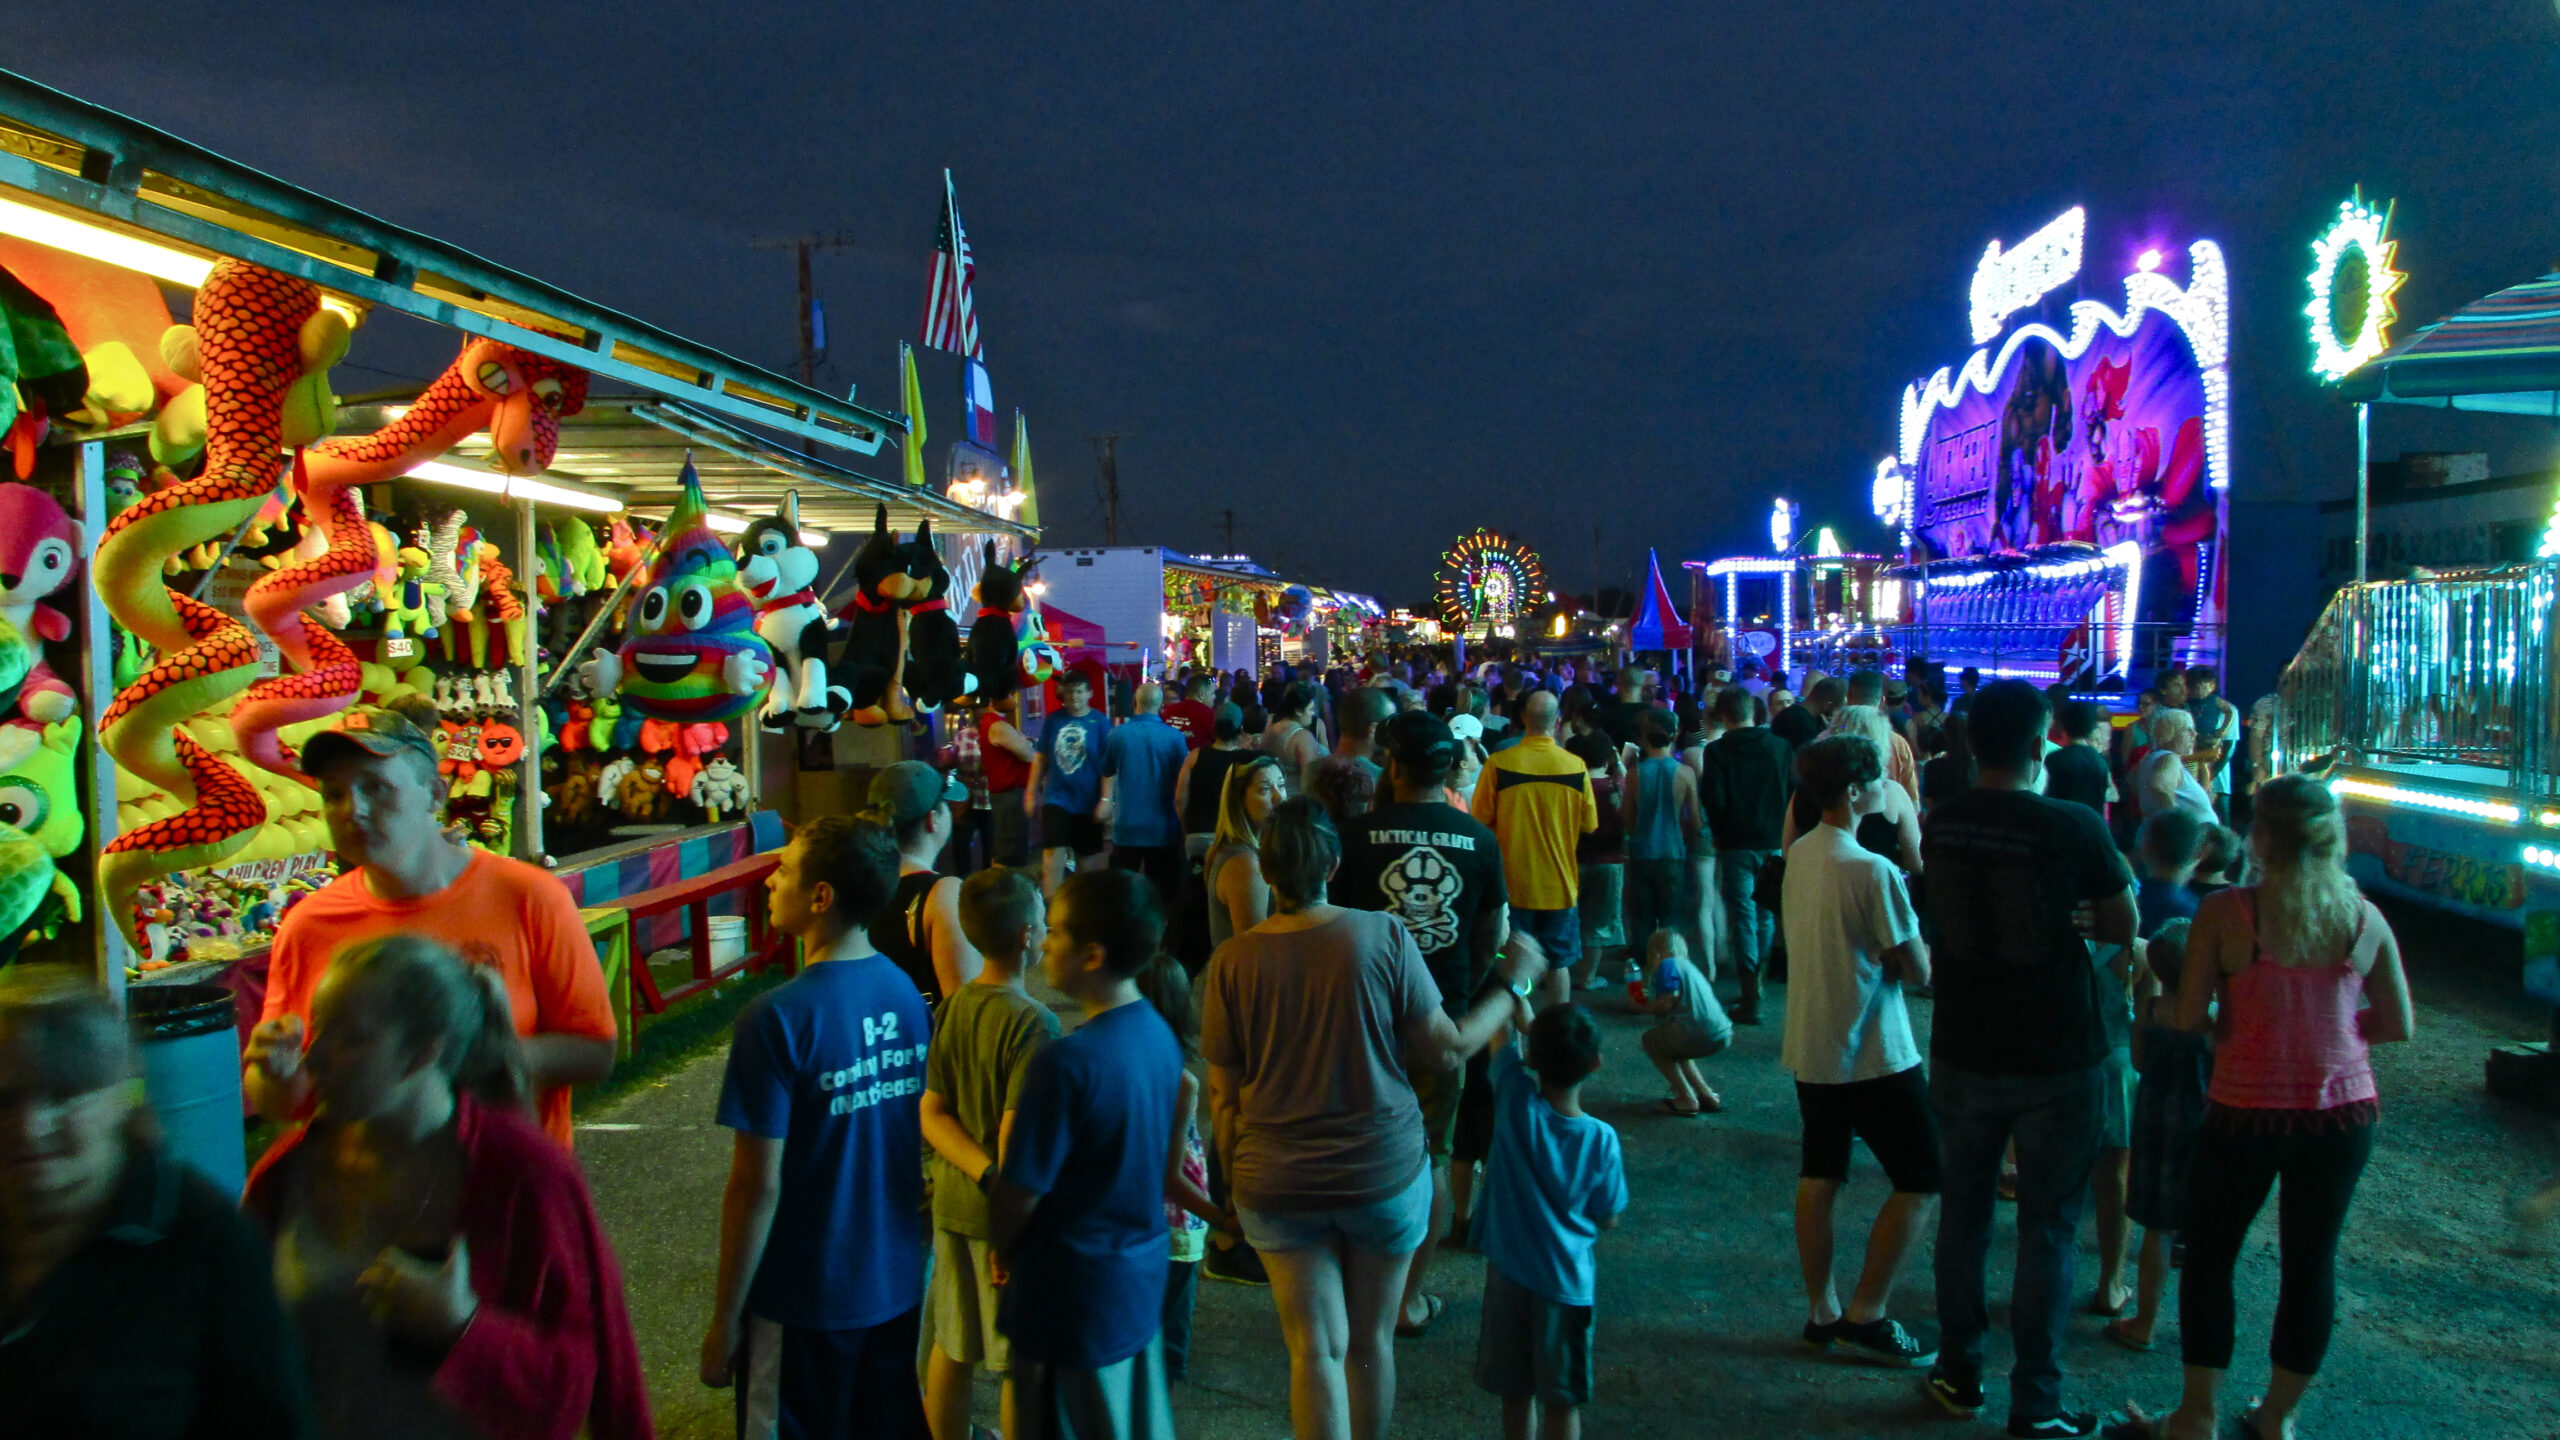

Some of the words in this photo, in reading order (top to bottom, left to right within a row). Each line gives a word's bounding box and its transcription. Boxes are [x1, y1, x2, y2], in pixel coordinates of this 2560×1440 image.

[388, 642, 412, 653] $40
[449, 746, 471, 758] $20
[1368, 829, 1430, 845] TACTICAL
[292, 852, 320, 875] PLAY
[882, 1048, 914, 1069] For
